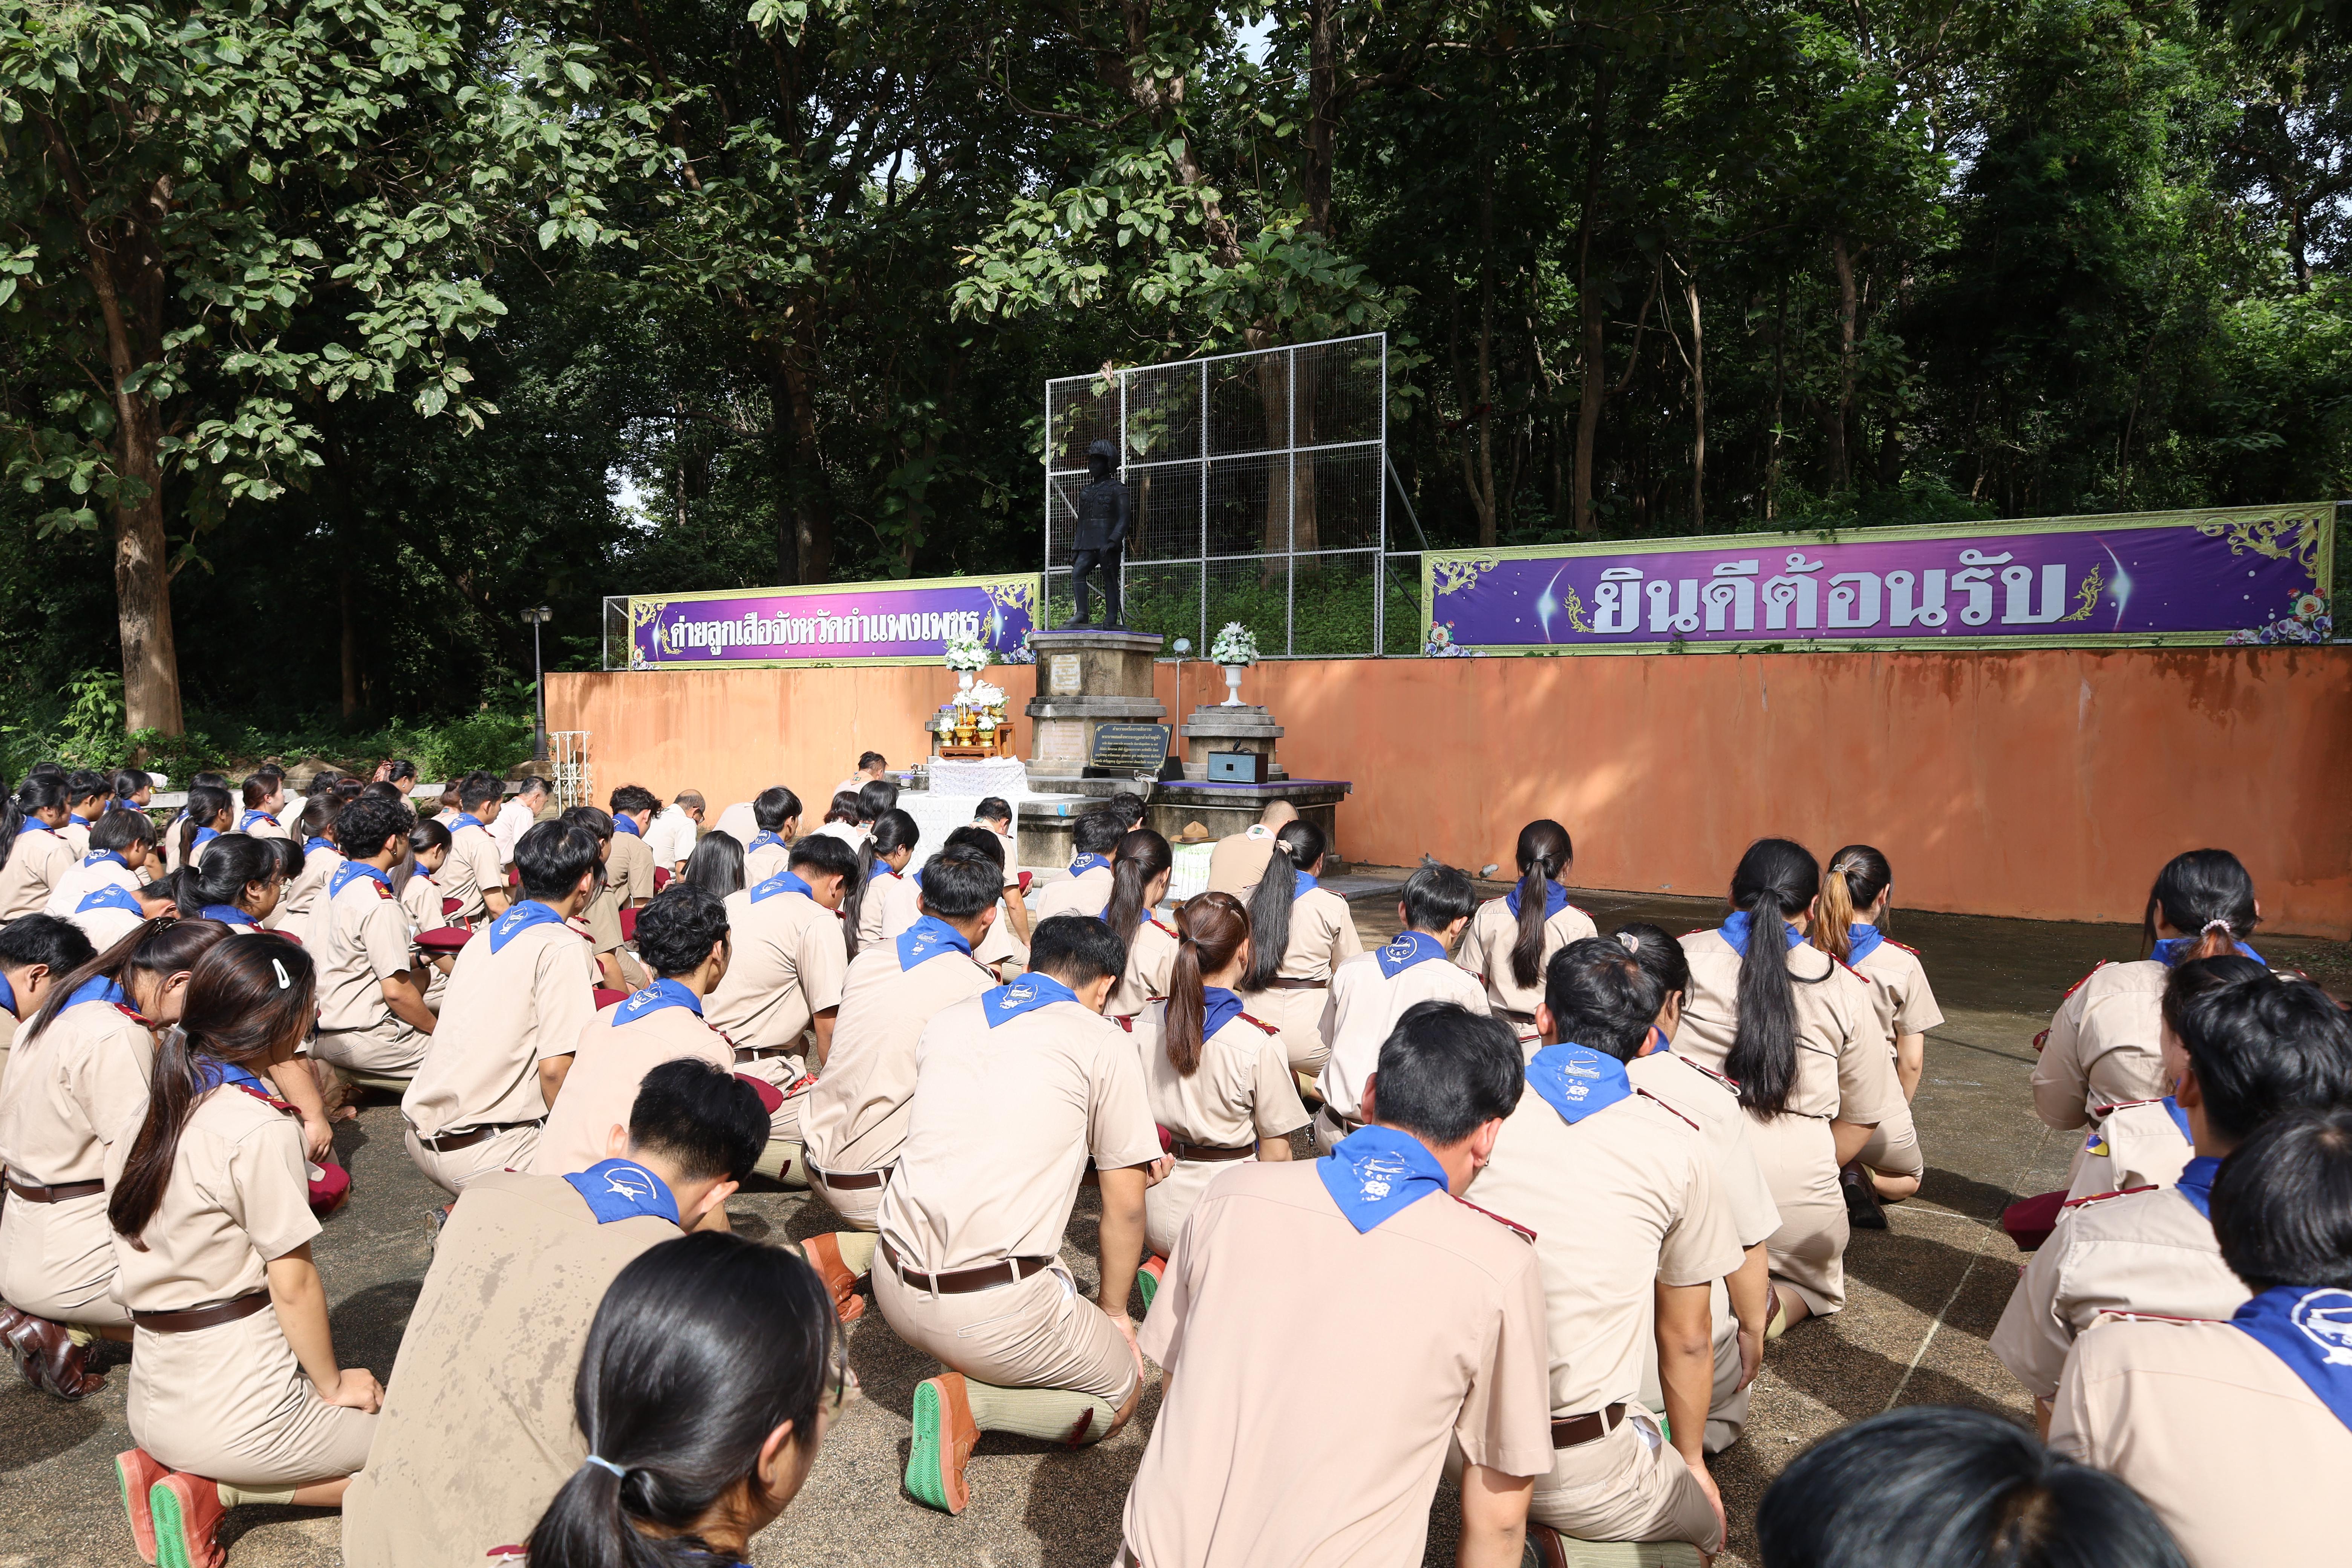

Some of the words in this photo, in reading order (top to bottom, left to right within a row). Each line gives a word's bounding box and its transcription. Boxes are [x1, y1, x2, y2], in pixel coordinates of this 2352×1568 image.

[1594, 549, 2066, 634] ยินดีต้อนรับ
[671, 607, 980, 655] ค่ายลูกเสือจังหวัดกำแพงเพชร
